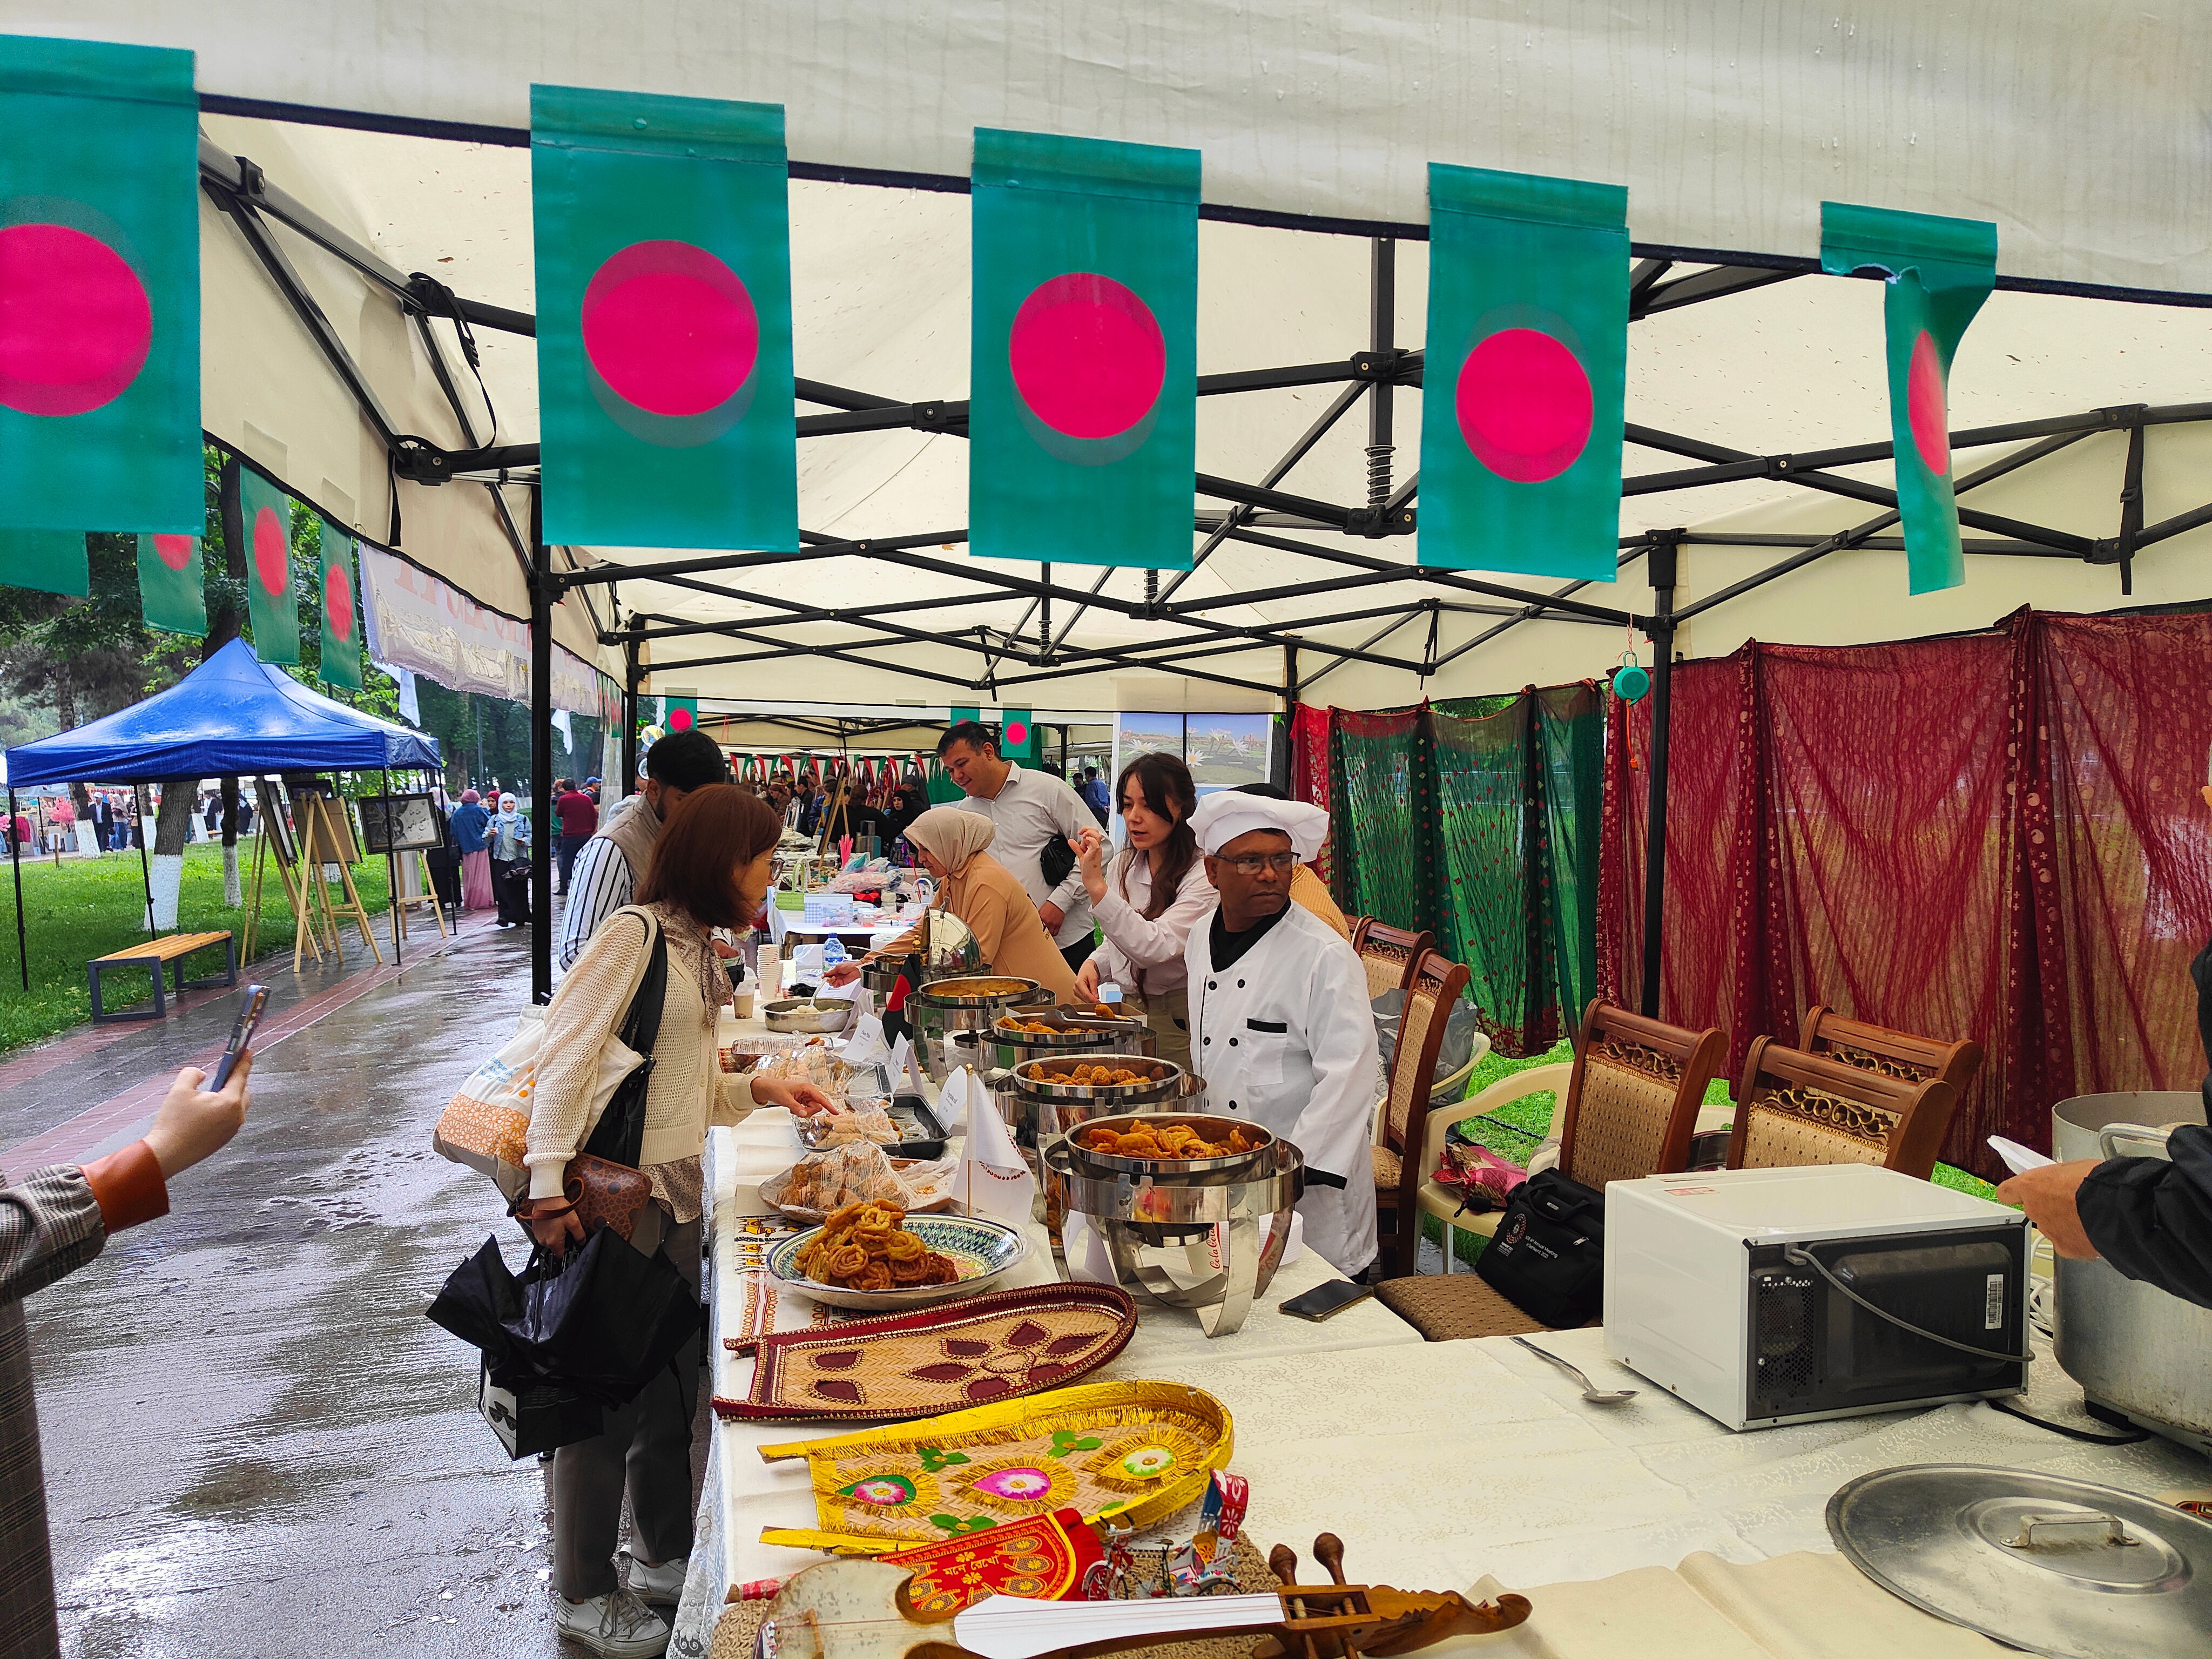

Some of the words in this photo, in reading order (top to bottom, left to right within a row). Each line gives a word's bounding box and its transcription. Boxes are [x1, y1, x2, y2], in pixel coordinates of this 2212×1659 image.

[1208, 1249, 1220, 1269] Cola
[1544, 1246, 1558, 1258] Meeting
[942, 1563, 967, 1576] মনে
[970, 1554, 1001, 1571] রেখো
